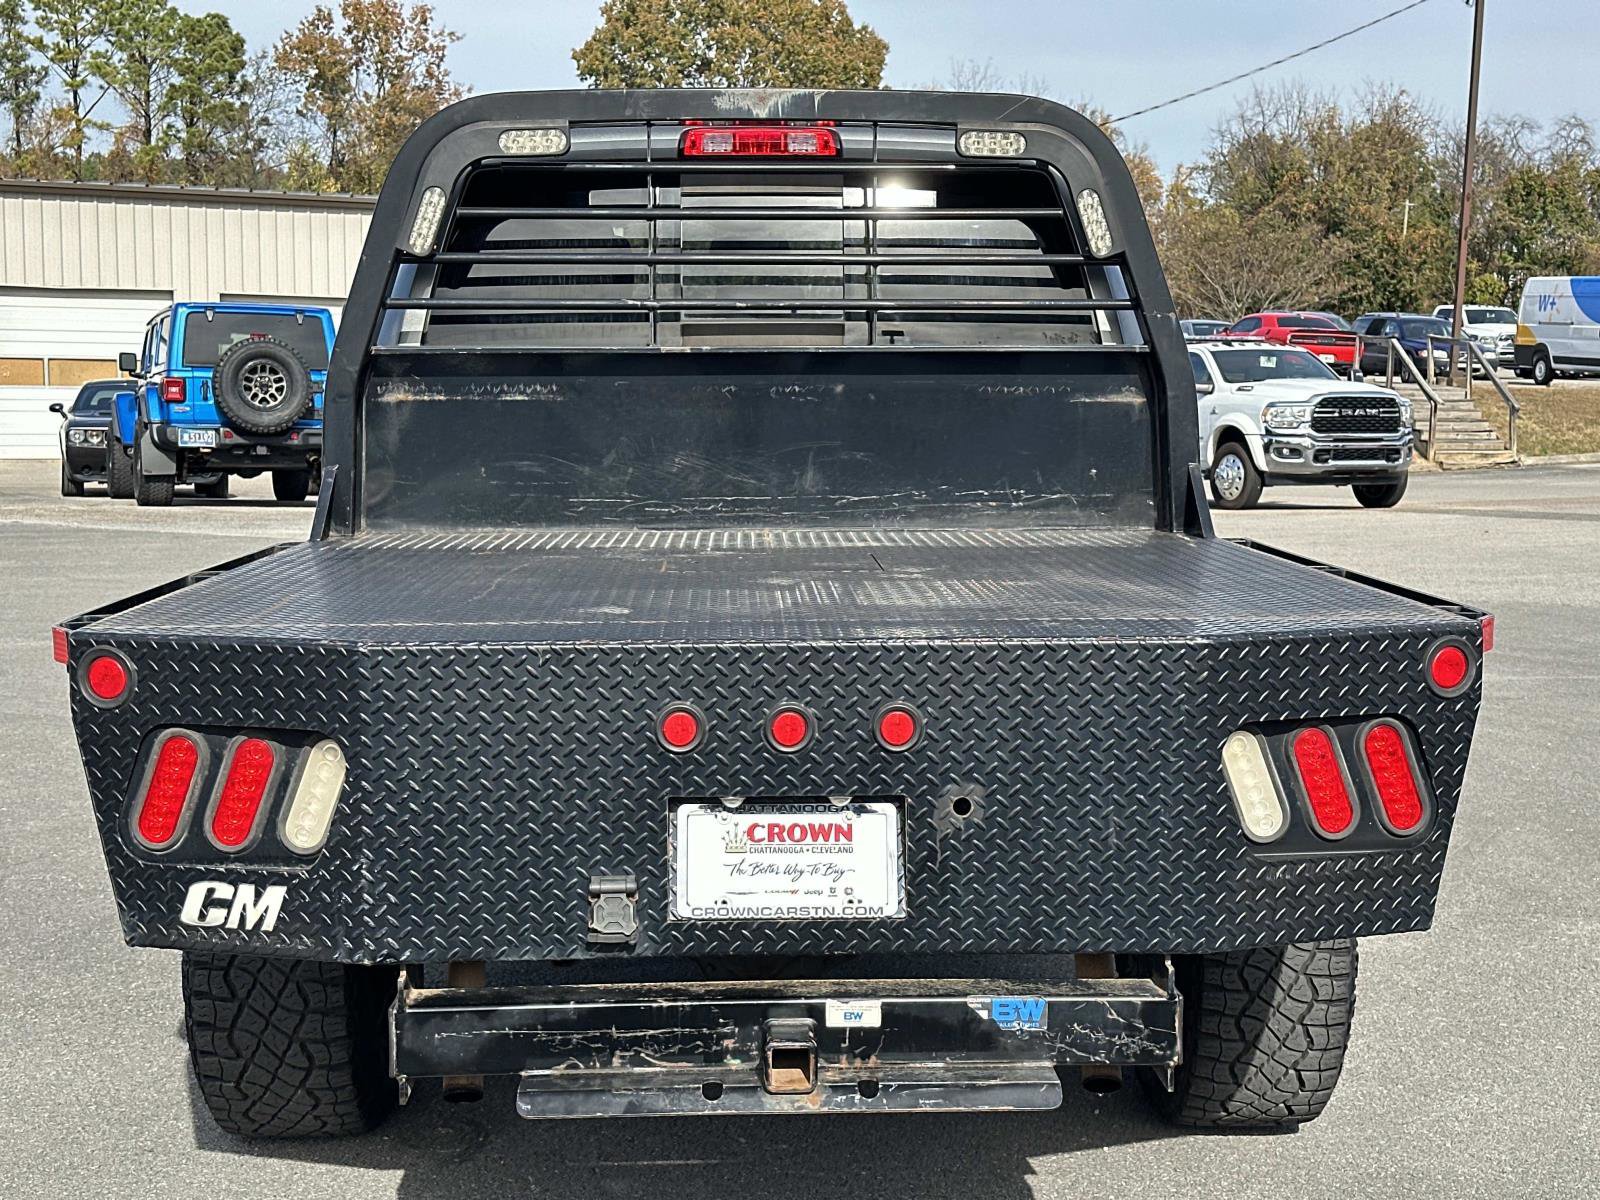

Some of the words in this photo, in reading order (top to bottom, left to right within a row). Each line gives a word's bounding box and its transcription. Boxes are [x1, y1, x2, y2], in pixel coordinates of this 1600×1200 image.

[1341, 408, 1379, 416] RAM
[746, 822, 853, 843] CROWN
[749, 846, 804, 854] CHATTANOOGA
[811, 846, 854, 854] CLEVELAND
[723, 858, 748, 876] The
[748, 862, 781, 876] Better
[806, 862, 821, 876] To
[822, 862, 855, 882] Buy
[181, 880, 288, 932] CM
[691, 906, 884, 917] CROWNCARSTN.COM
